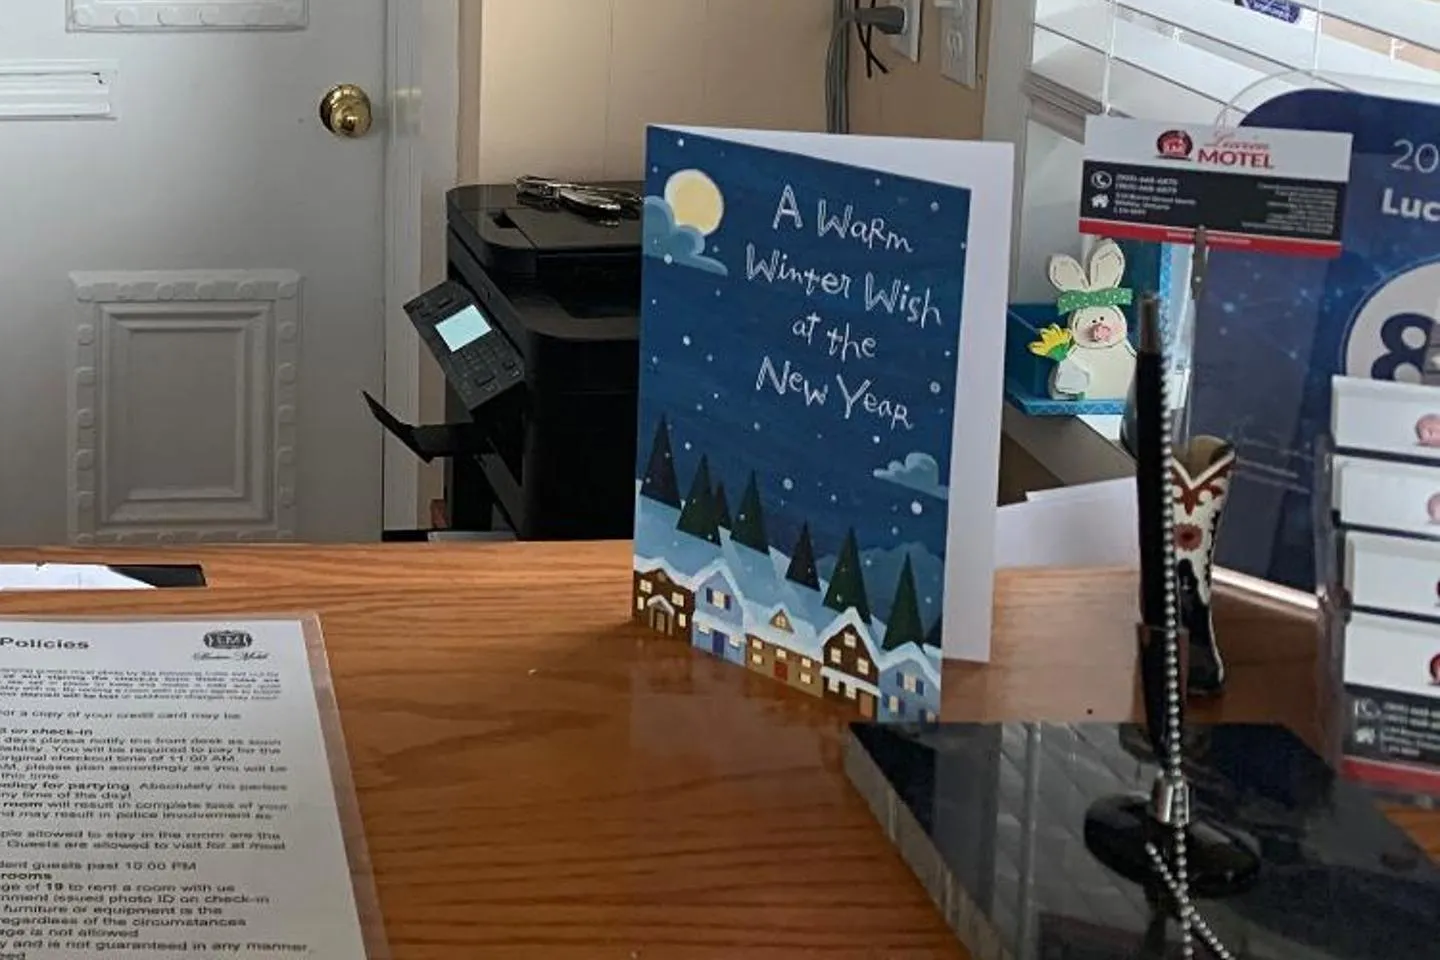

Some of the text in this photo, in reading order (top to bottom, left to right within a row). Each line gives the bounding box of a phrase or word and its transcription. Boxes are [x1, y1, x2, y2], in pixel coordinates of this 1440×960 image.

[1197, 148, 1274, 169] MOTEL
[772, 183, 803, 229] A
[746, 243, 941, 328] Winter Wish
[792, 312, 877, 363] at the
[756, 356, 828, 406] New
[0, 637, 90, 650] Policies
